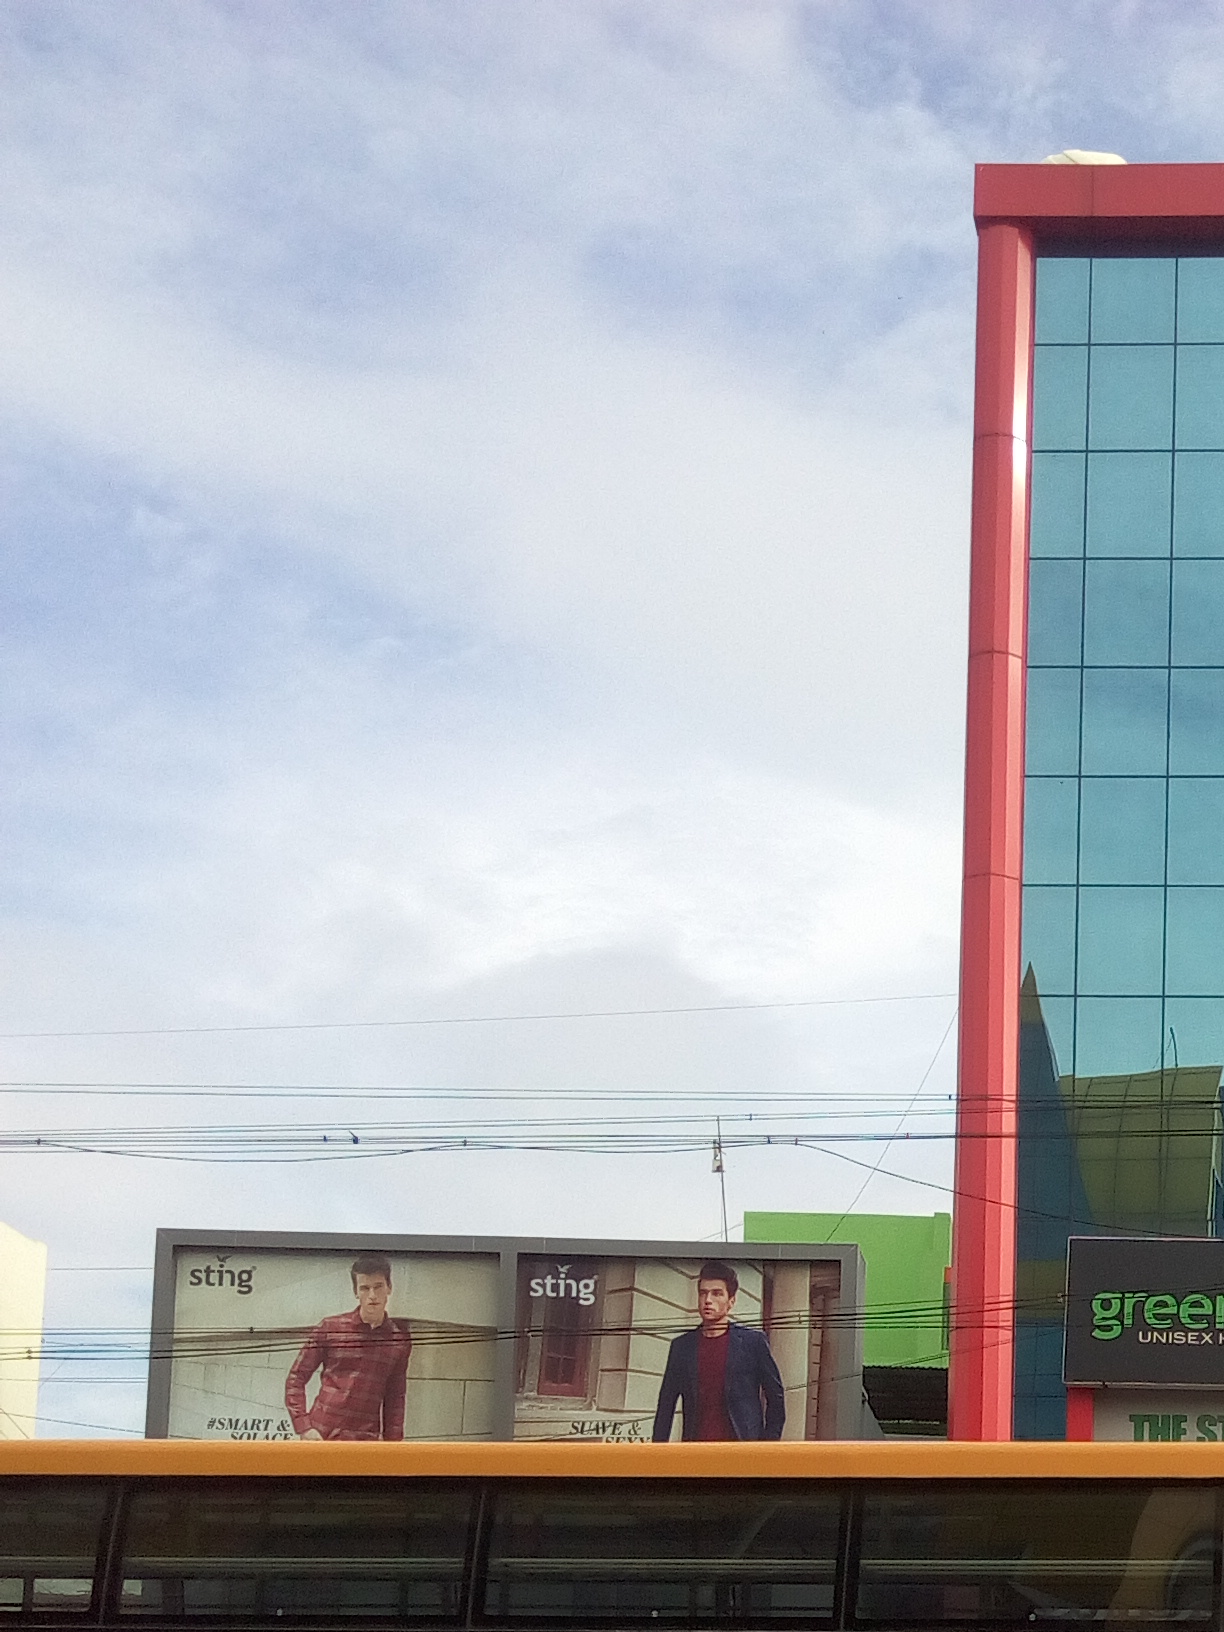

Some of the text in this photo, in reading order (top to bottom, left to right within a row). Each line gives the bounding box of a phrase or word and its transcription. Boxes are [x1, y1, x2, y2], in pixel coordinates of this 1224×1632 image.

[189, 1263, 254, 1295] sting
[529, 1271, 596, 1305] sting
[1138, 1331, 1214, 1346] UNISEX
[206, 1417, 273, 1432] #SMART
